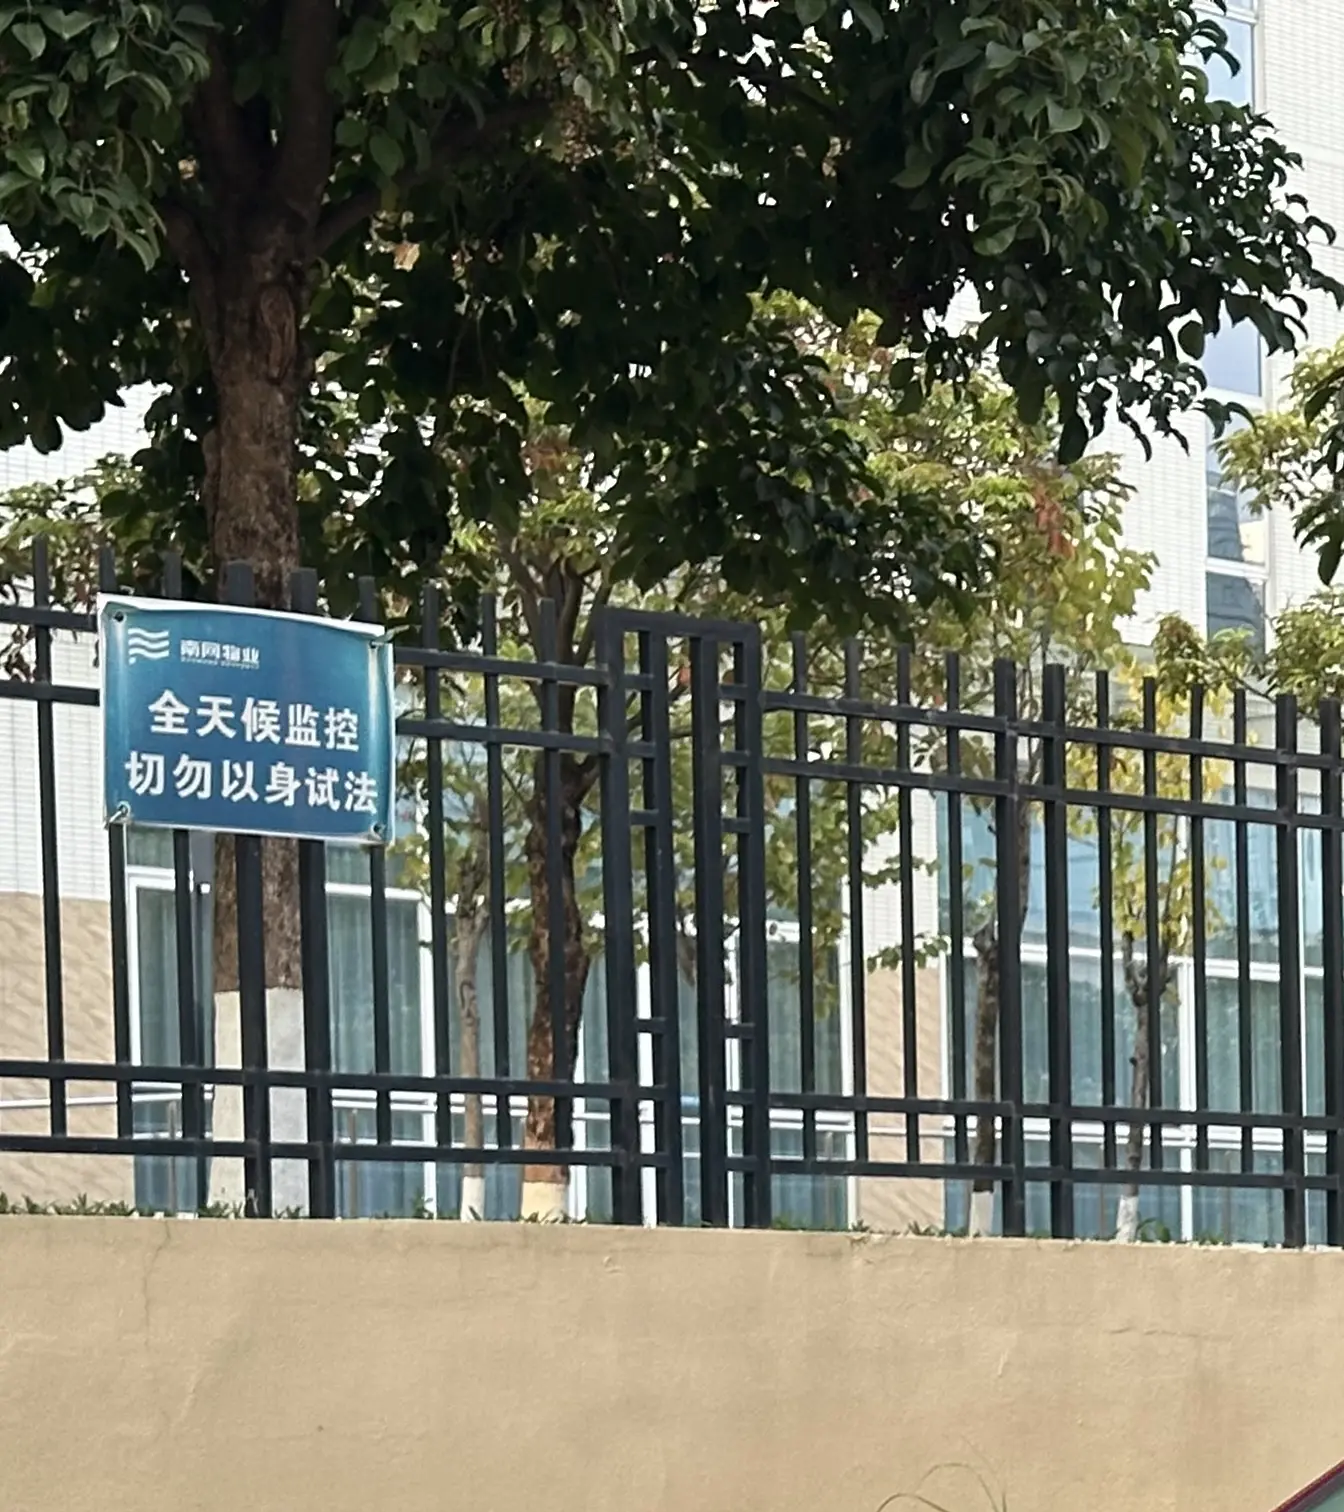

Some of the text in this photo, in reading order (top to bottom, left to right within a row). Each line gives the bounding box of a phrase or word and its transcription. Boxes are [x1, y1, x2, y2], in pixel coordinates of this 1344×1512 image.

[148, 690, 360, 752] 全天候监控
[124, 751, 379, 815] 切勿以身试法
